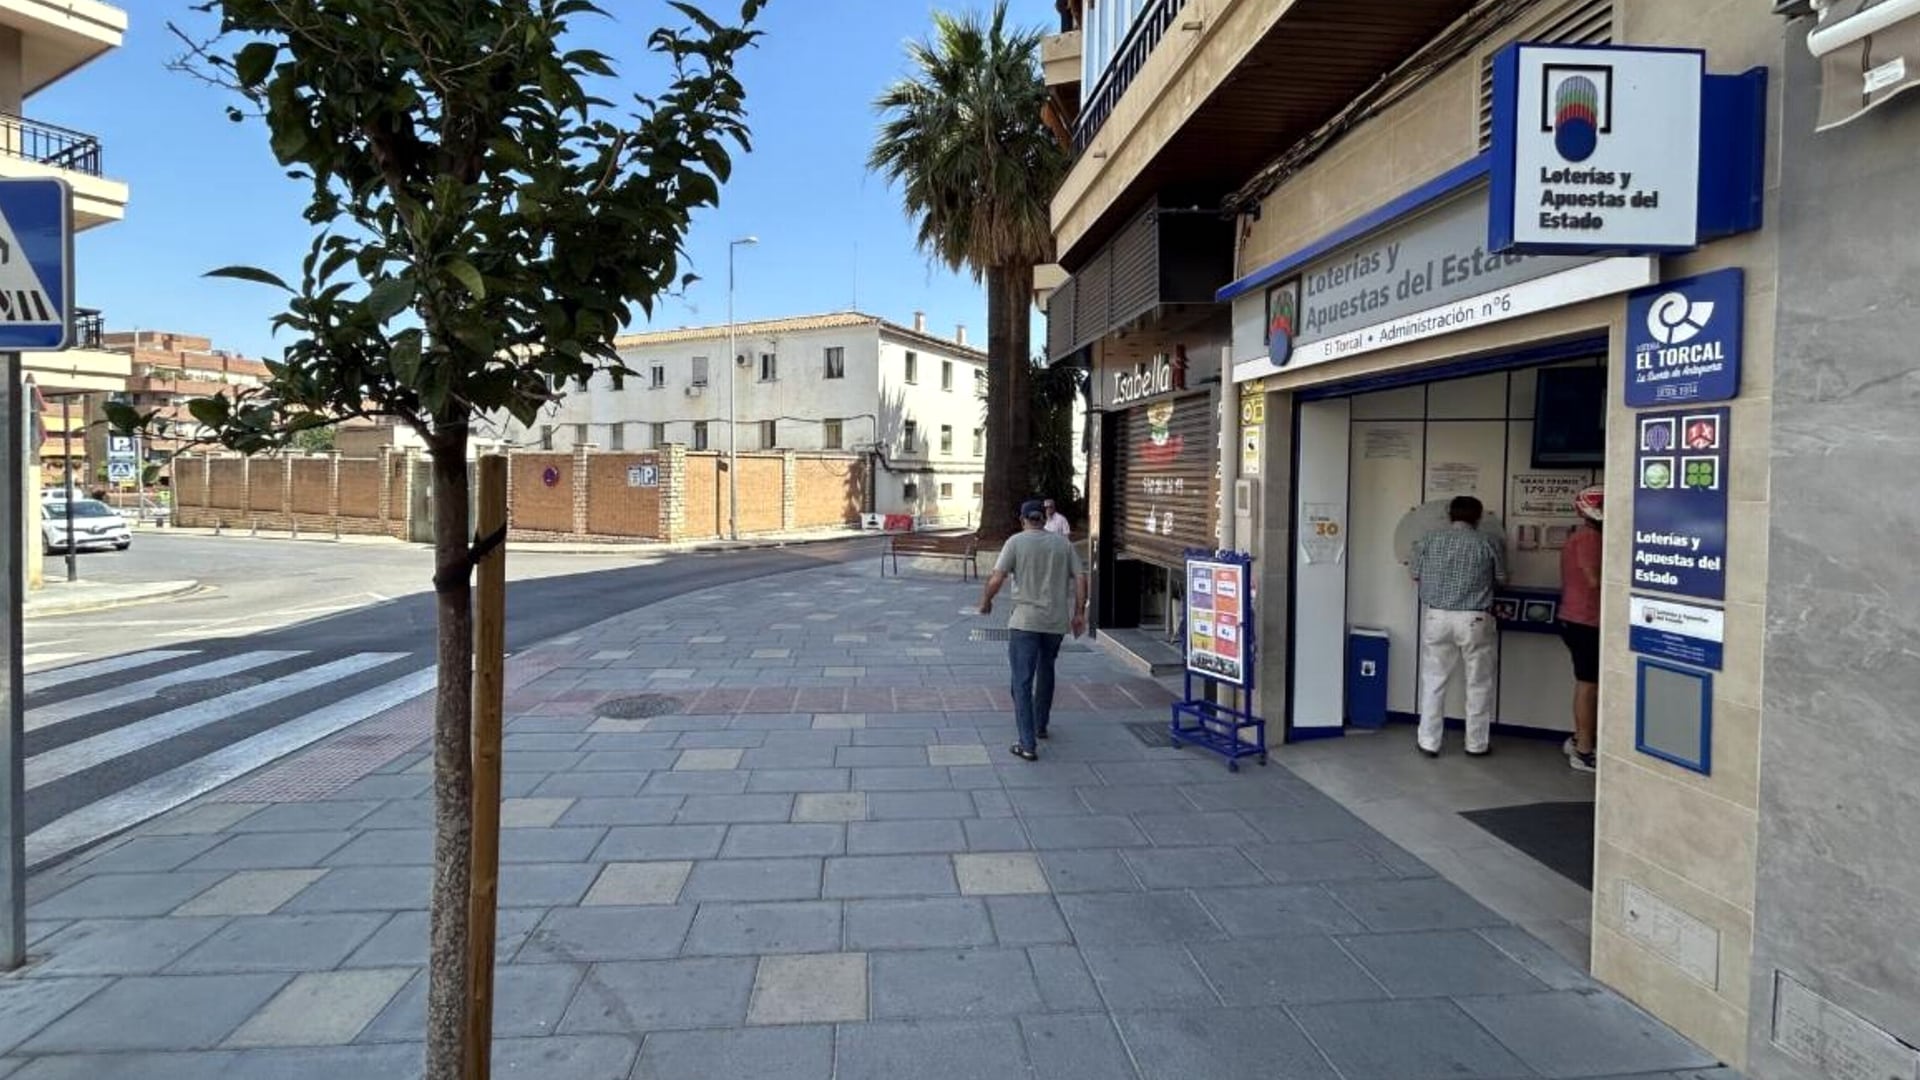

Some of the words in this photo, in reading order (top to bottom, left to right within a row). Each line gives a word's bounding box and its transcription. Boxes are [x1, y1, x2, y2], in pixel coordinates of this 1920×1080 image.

[1541, 166, 1615, 185] Loterías
[1619, 172, 1631, 189] y
[1540, 189, 1626, 210] Apuestas
[1630, 190, 1658, 208] del
[1539, 212, 1603, 230] Estado
[1386, 242, 1400, 274] y
[1305, 285, 1390, 334] Apuestas
[1397, 260, 1434, 301] del
[1324, 343, 1333, 356] El
[1335, 334, 1363, 352] Torcal
[1379, 306, 1474, 342] Administración
[1636, 352, 1653, 370] EL
[1658, 341, 1724, 368] TORCAL
[1112, 352, 1171, 404] Isabella
[1316, 522, 1339, 536] 30
[1636, 531, 1688, 547] Loterías
[1691, 537, 1701, 551] y
[1635, 550, 1694, 568] Apuestas
[1698, 556, 1721, 570] del
[1635, 568, 1679, 585] Estado
